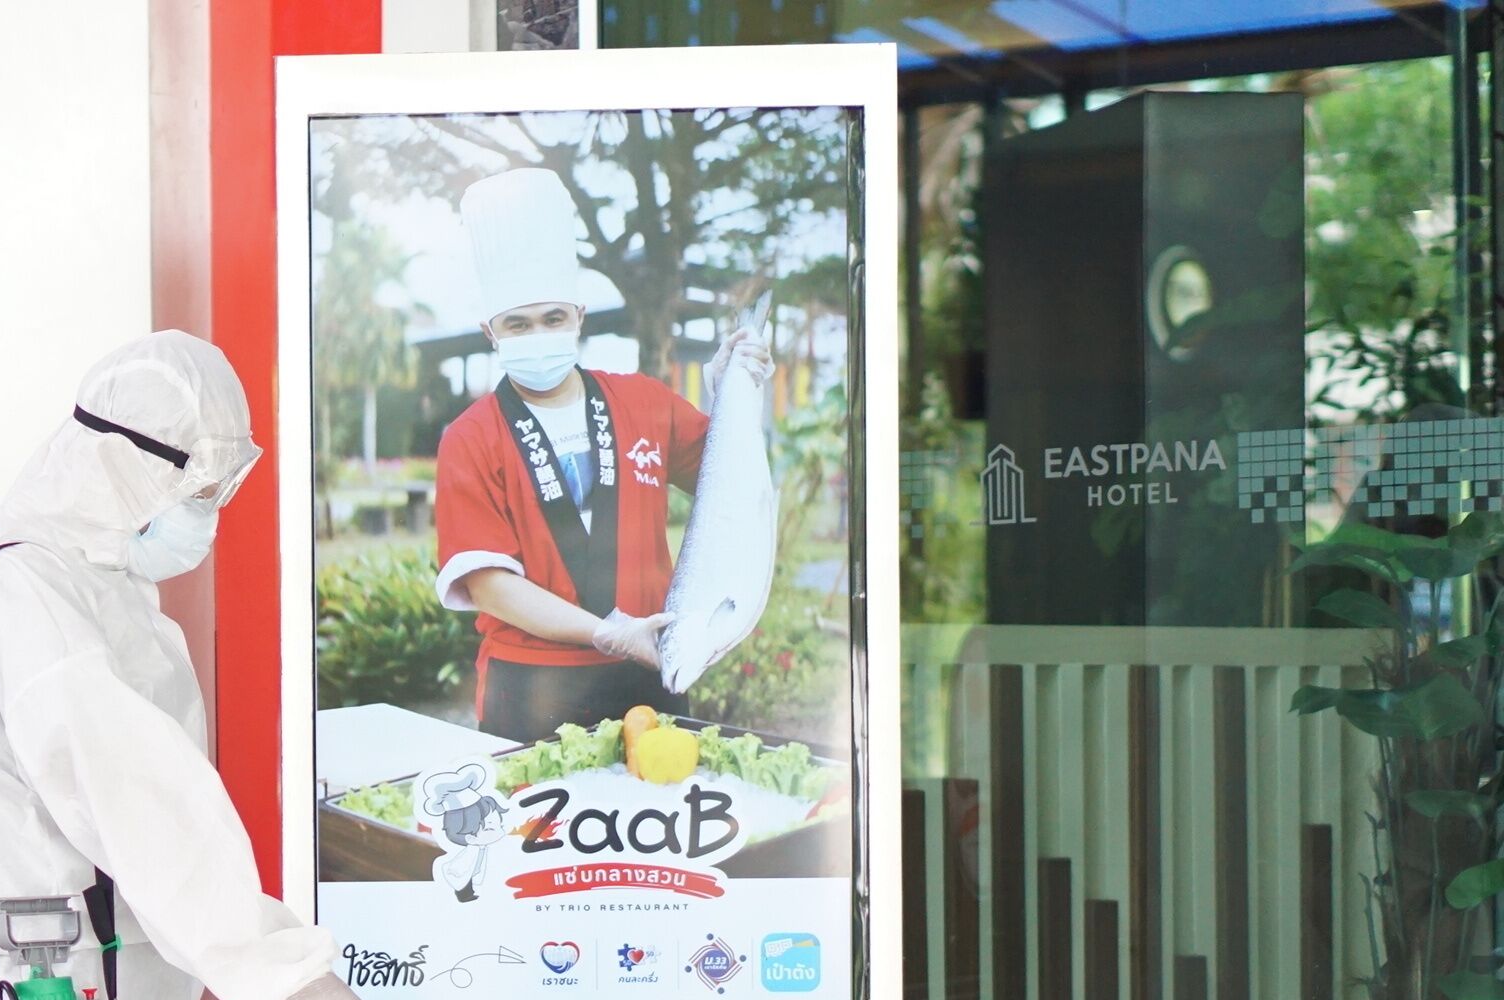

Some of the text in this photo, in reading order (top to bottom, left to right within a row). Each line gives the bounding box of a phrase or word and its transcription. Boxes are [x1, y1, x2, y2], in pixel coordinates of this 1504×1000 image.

[1044, 439, 1227, 479] EASTPANA
[1087, 482, 1179, 507] HOTEL
[518, 783, 740, 860] ZaaB
[553, 866, 686, 887] แซ่บกลางสวน
[535, 903, 689, 912] BY TRIO RESTAURANT
[542, 977, 578, 986] เราชนะ
